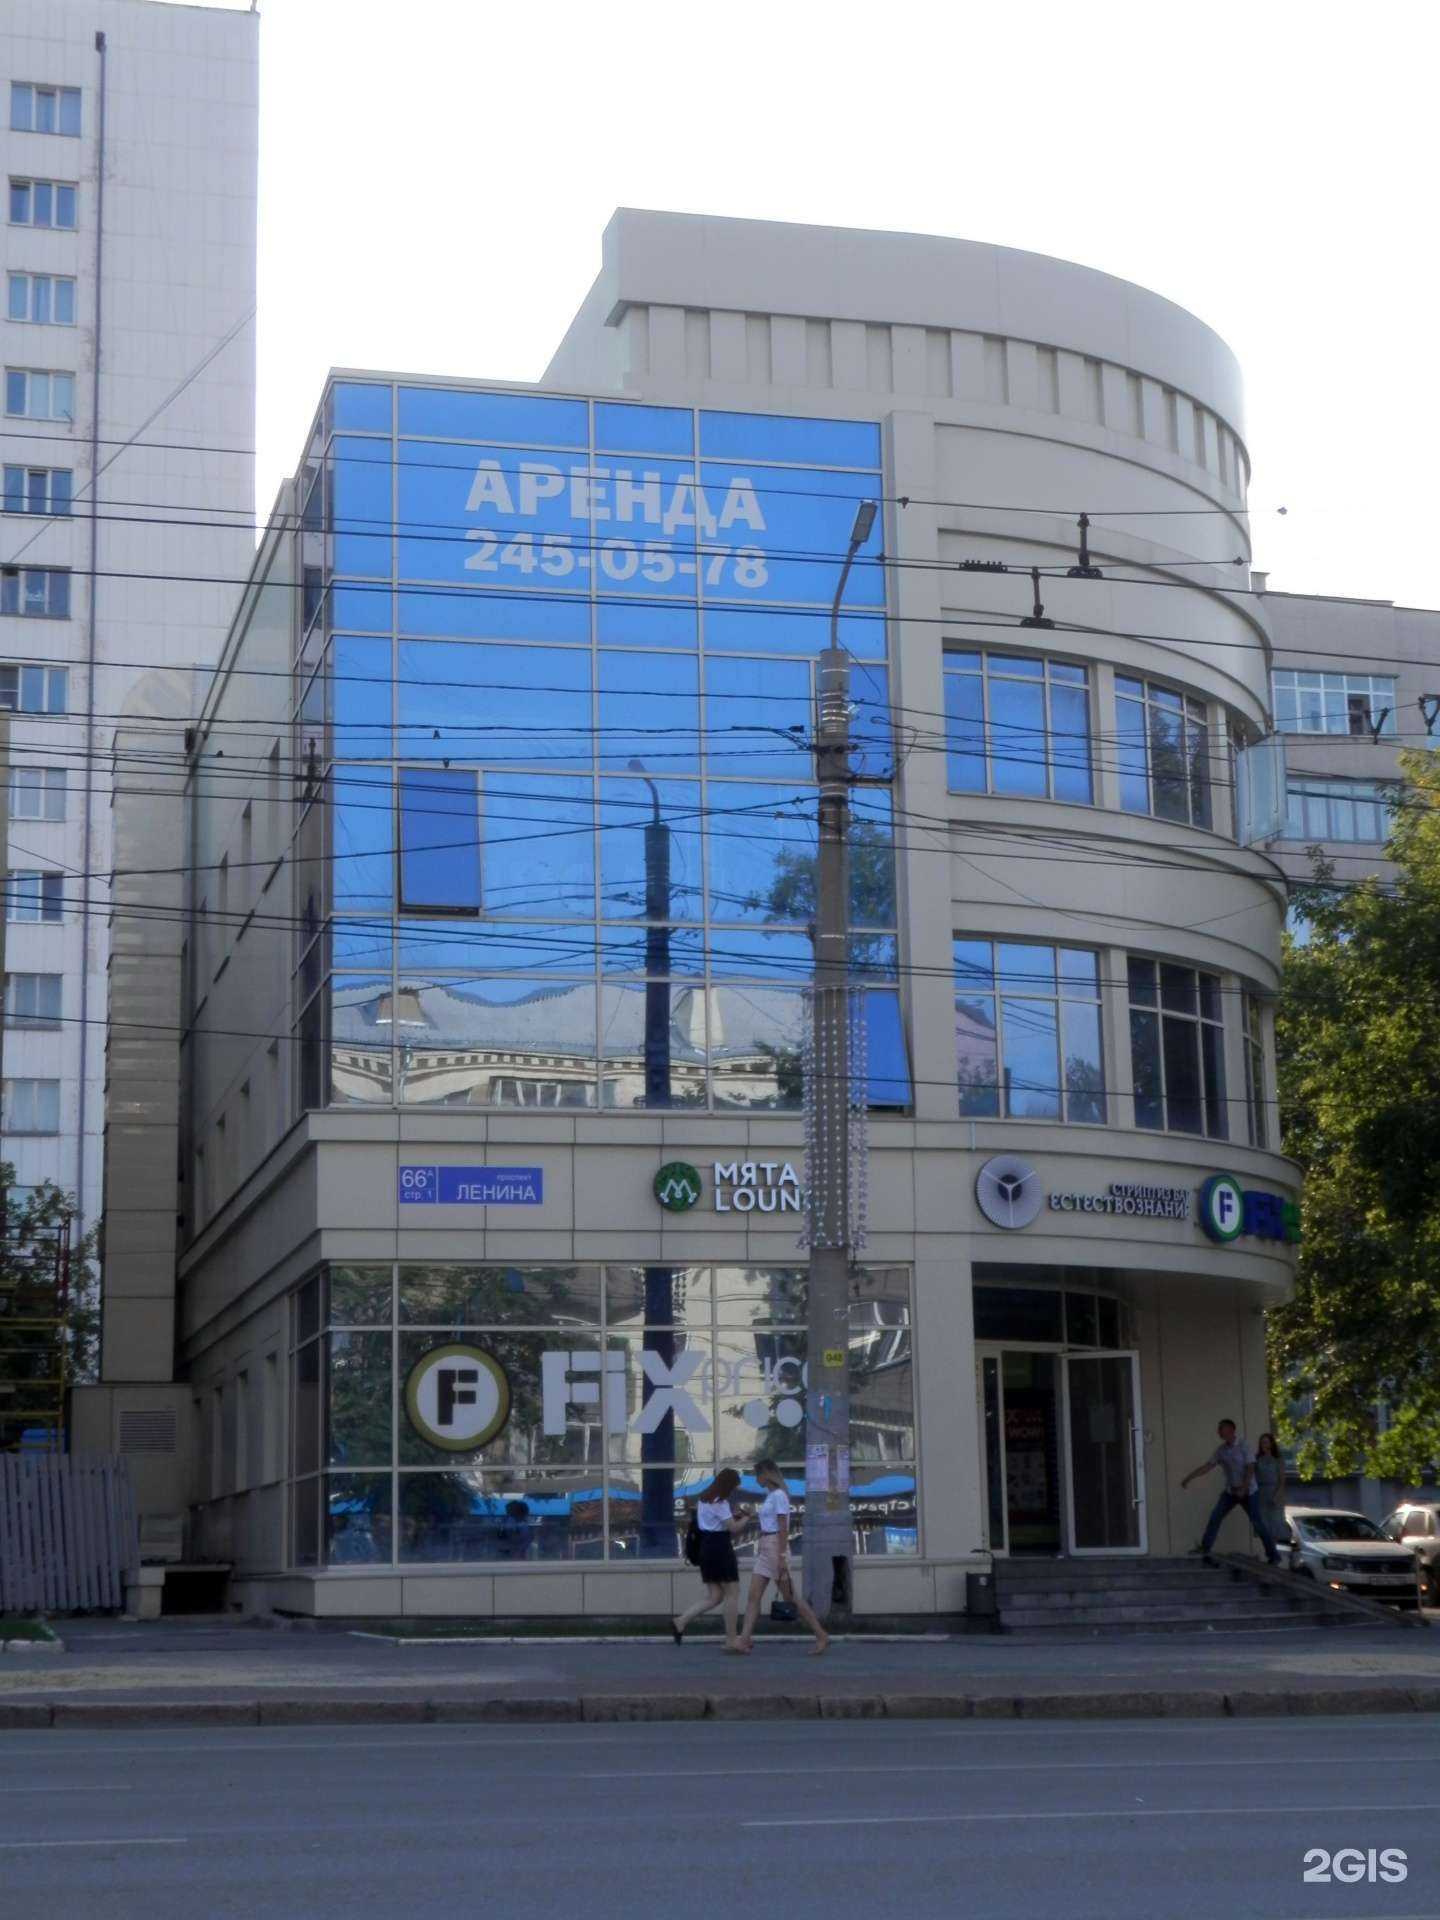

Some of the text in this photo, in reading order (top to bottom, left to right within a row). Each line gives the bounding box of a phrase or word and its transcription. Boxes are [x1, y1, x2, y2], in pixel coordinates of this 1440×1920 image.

[465, 459, 766, 537] АРЕНДА
[464, 527, 769, 588] 245-05-78
[457, 1184, 537, 1201] ЛЕНИНА
[714, 1162, 799, 1186] МЯТА
[715, 1188, 803, 1212] LOUN
[541, 1350, 713, 1435] FIX
